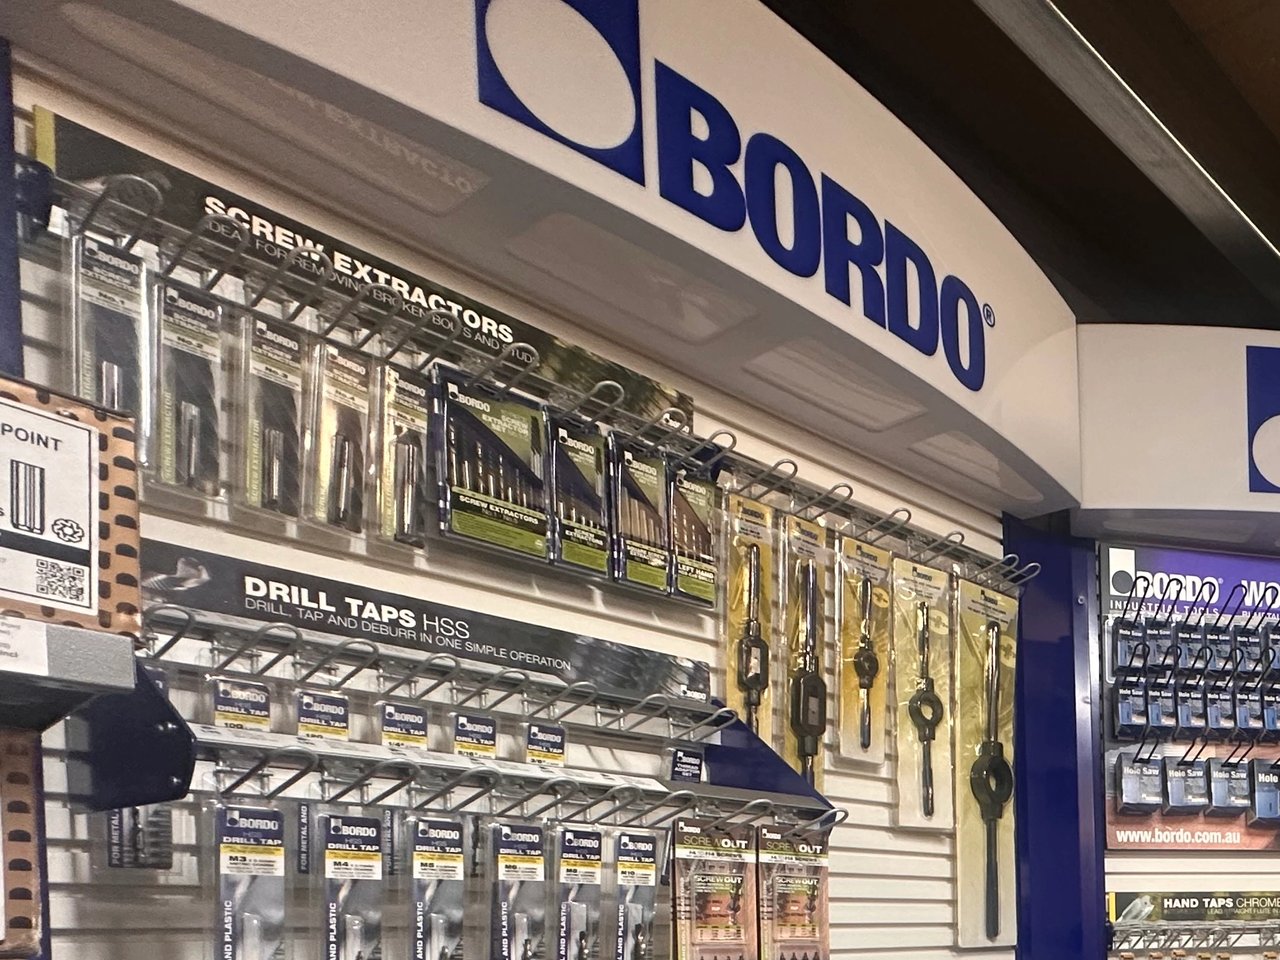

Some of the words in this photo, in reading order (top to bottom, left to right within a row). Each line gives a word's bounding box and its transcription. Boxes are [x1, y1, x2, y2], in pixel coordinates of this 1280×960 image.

[205, 196, 325, 261] SCREW
[334, 251, 514, 343] EXTRACTORS
[459, 393, 490, 412] BORDO
[1, 422, 62, 452] POINT
[567, 438, 594, 454] BORDO
[244, 576, 336, 613] DRILL
[345, 597, 416, 627] TAPS
[423, 613, 470, 639] HSS
[298, 607, 323, 621] TAP
[328, 613, 358, 629] AND
[362, 620, 416, 641] DEBURR
[420, 633, 432, 643] IN
[436, 636, 463, 649] ONE
[465, 640, 507, 659] SIMPLE
[510, 649, 571, 671] OPERATION
[230, 690, 265, 702] BORDO
[314, 702, 345, 715] BORDO
[394, 711, 423, 724] BORDO
[466, 721, 493, 734] BORDO
[538, 731, 562, 743] BORDO
[1258, 773, 1278, 783] Hole
[240, 818, 278, 830] BORDO
[342, 825, 377, 837] BORDO
[429, 829, 459, 839] BORDO
[511, 832, 539, 842] BORDO
[1116, 828, 1241, 844] www.bordo.com.au
[574, 838, 598, 848] BORDO
[630, 842, 652, 851] BORDO
[1163, 898, 1199, 908] HAND
[1202, 898, 1234, 908] TAPS
[224, 900, 233, 941] PLASTIC
